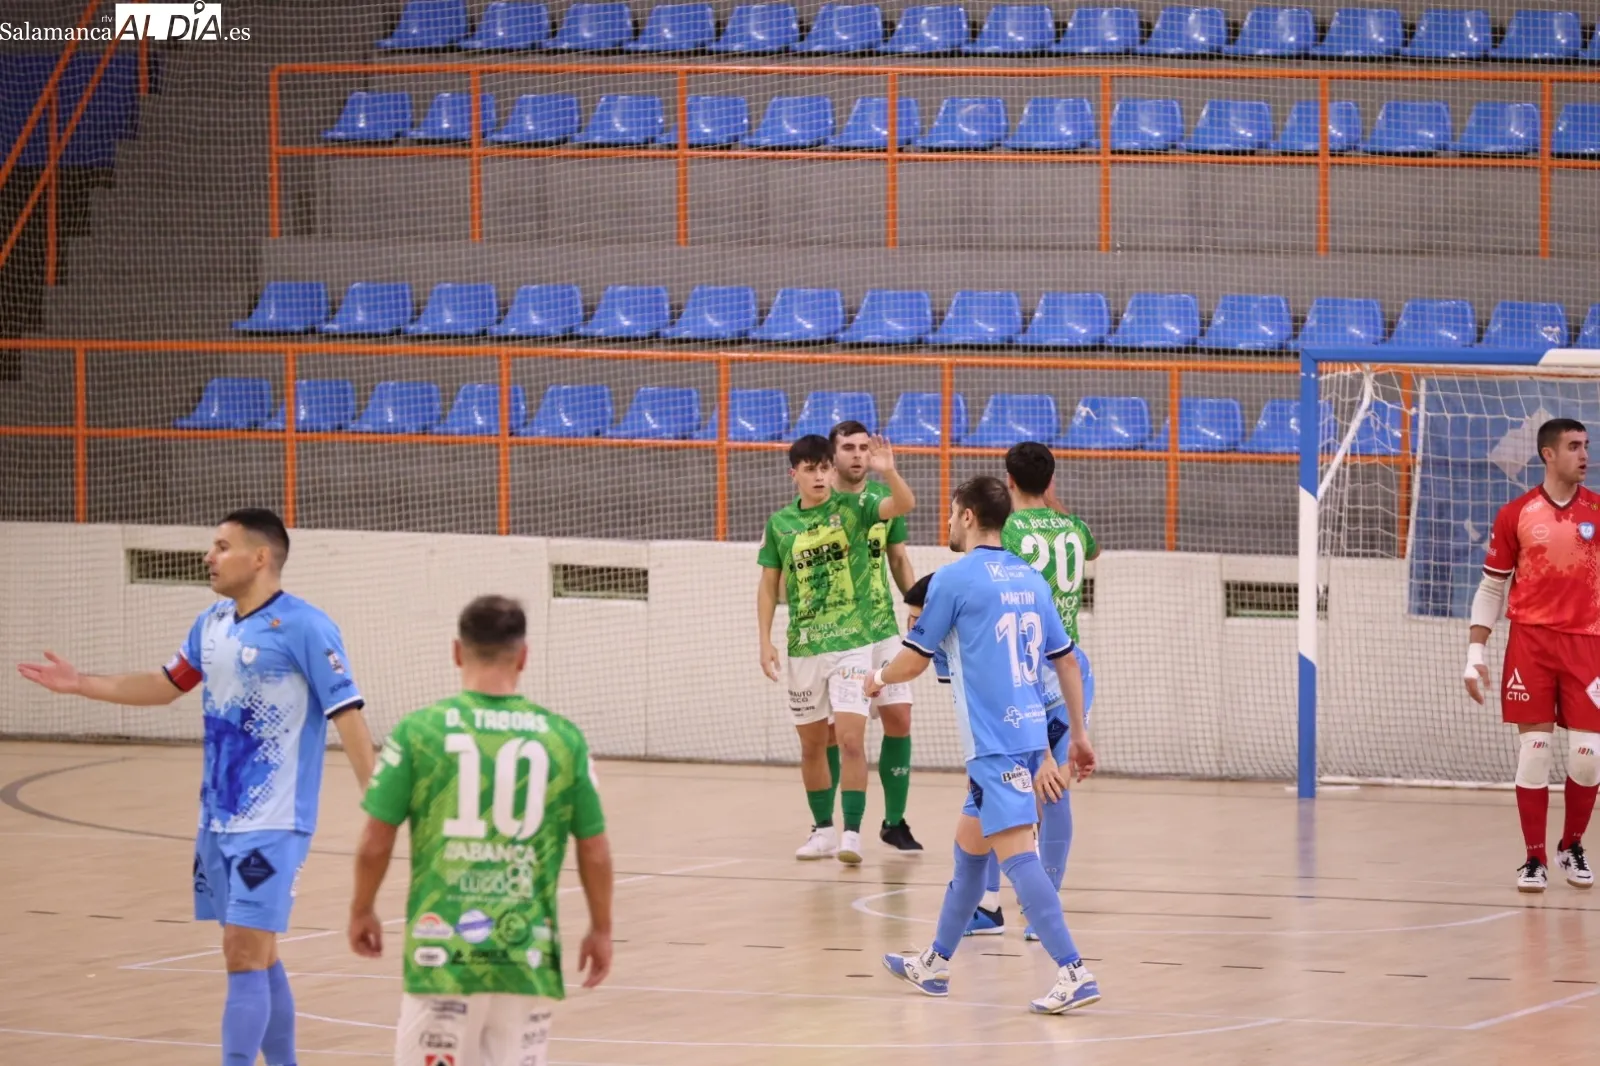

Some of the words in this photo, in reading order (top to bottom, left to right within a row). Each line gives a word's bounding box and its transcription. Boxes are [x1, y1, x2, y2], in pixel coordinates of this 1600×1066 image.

[1021, 531, 1084, 593] 20
[995, 611, 1043, 688] 13
[443, 733, 549, 841] 10
